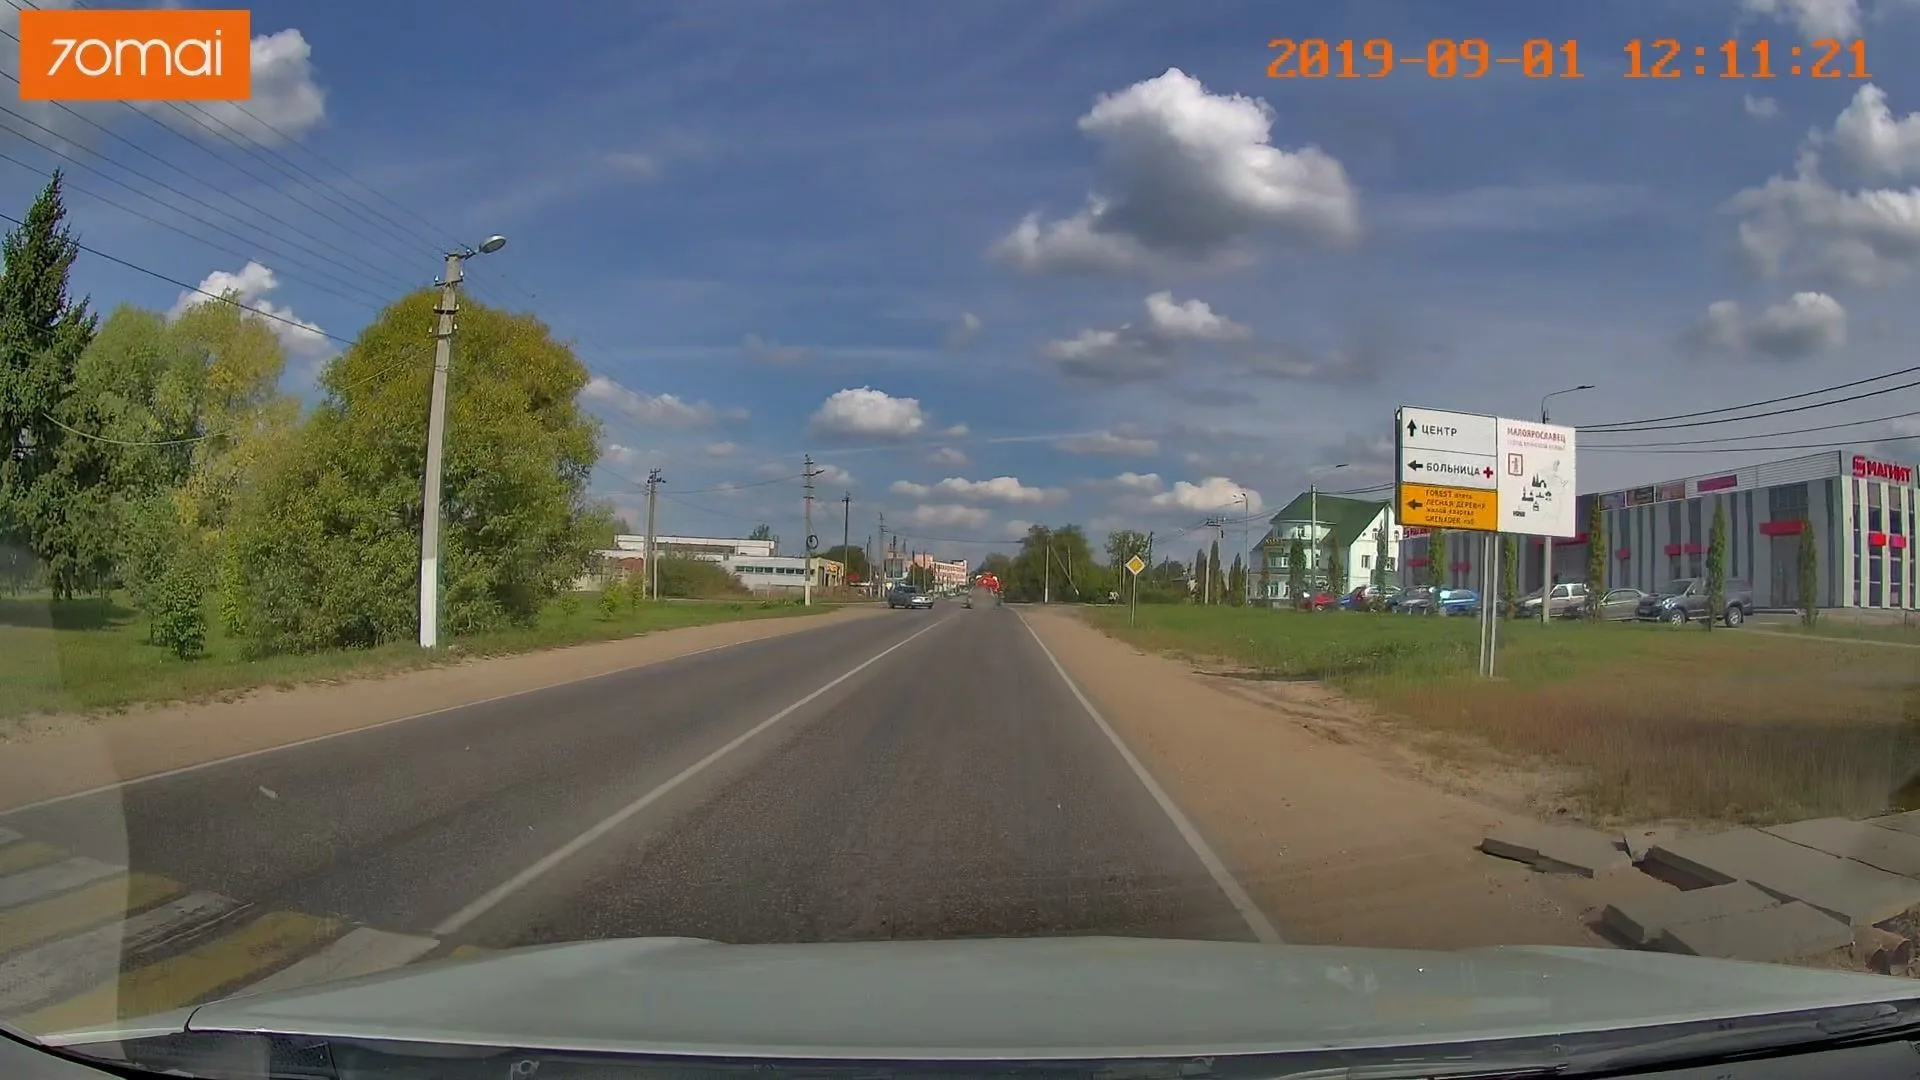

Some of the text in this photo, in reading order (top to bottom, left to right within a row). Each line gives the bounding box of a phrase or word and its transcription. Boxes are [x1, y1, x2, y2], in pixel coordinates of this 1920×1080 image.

[1421, 424, 1457, 437] ЦЕНТР
[1507, 427, 1566, 443] МАЛОЯРОСЛАВЕЦ
[1426, 462, 1480, 476] БОЛЬНИЦА
[1866, 461, 1911, 482] МАГНИТ
[1426, 489, 1452, 499] FOREST
[1426, 499, 1486, 510] ЛЕСНАЯ ДЕРЕВНЯ
